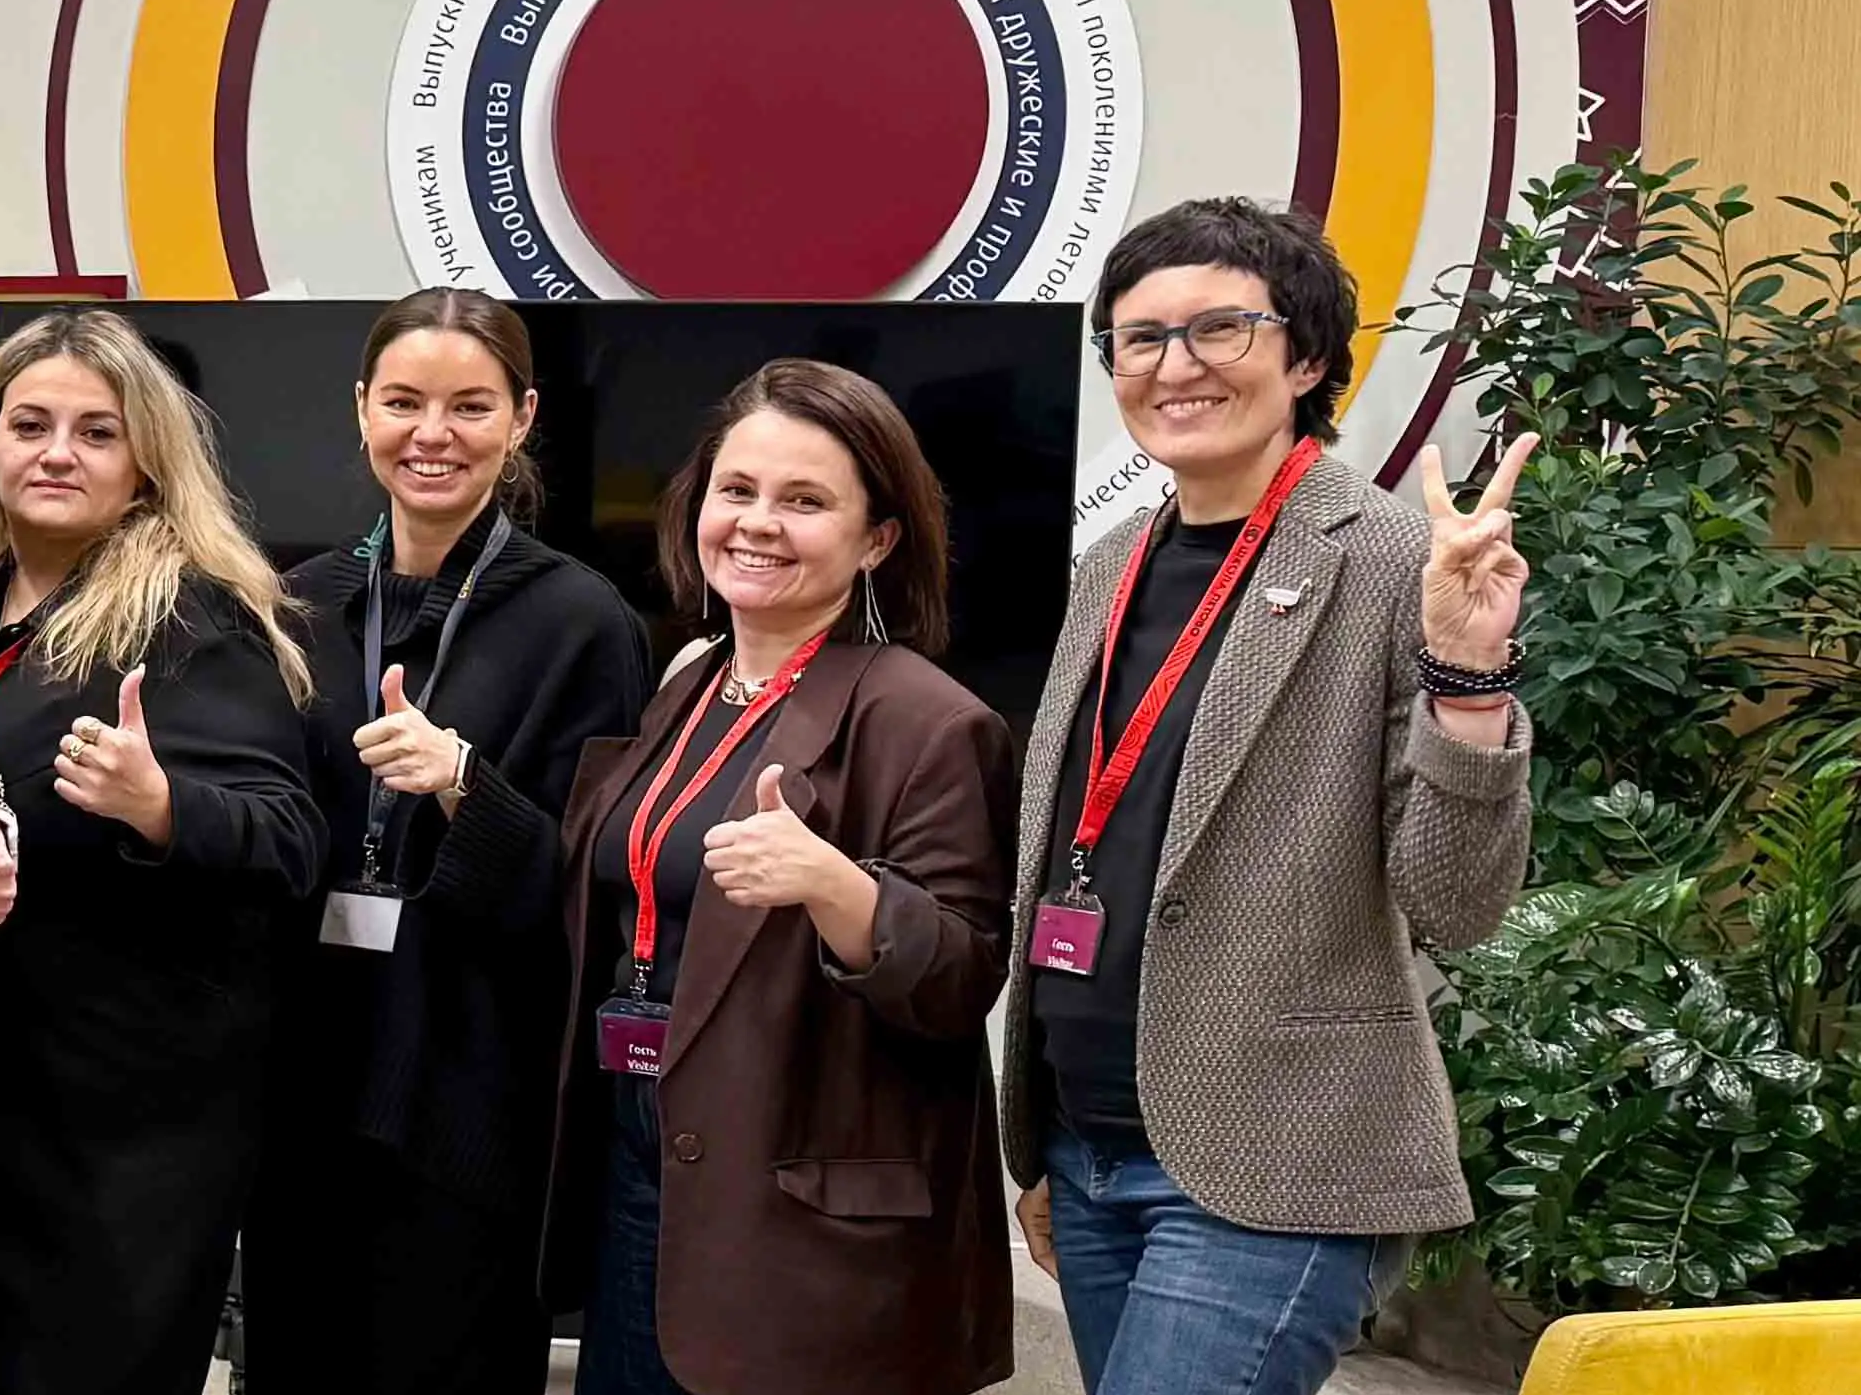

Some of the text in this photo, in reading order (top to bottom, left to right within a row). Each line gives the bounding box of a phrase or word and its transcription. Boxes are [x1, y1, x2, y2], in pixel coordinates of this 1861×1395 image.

[995, 12, 1043, 187] дружеские
[1080, 15, 1116, 214] поколениями
[485, 81, 539, 262] сообщества
[1000, 196, 1026, 218] и
[416, 144, 476, 282] ученикам
[934, 223, 1012, 301] проф
[1032, 221, 1090, 302] летов
[627, 1059, 660, 1072] Visitor
[629, 1043, 658, 1056] Гость
